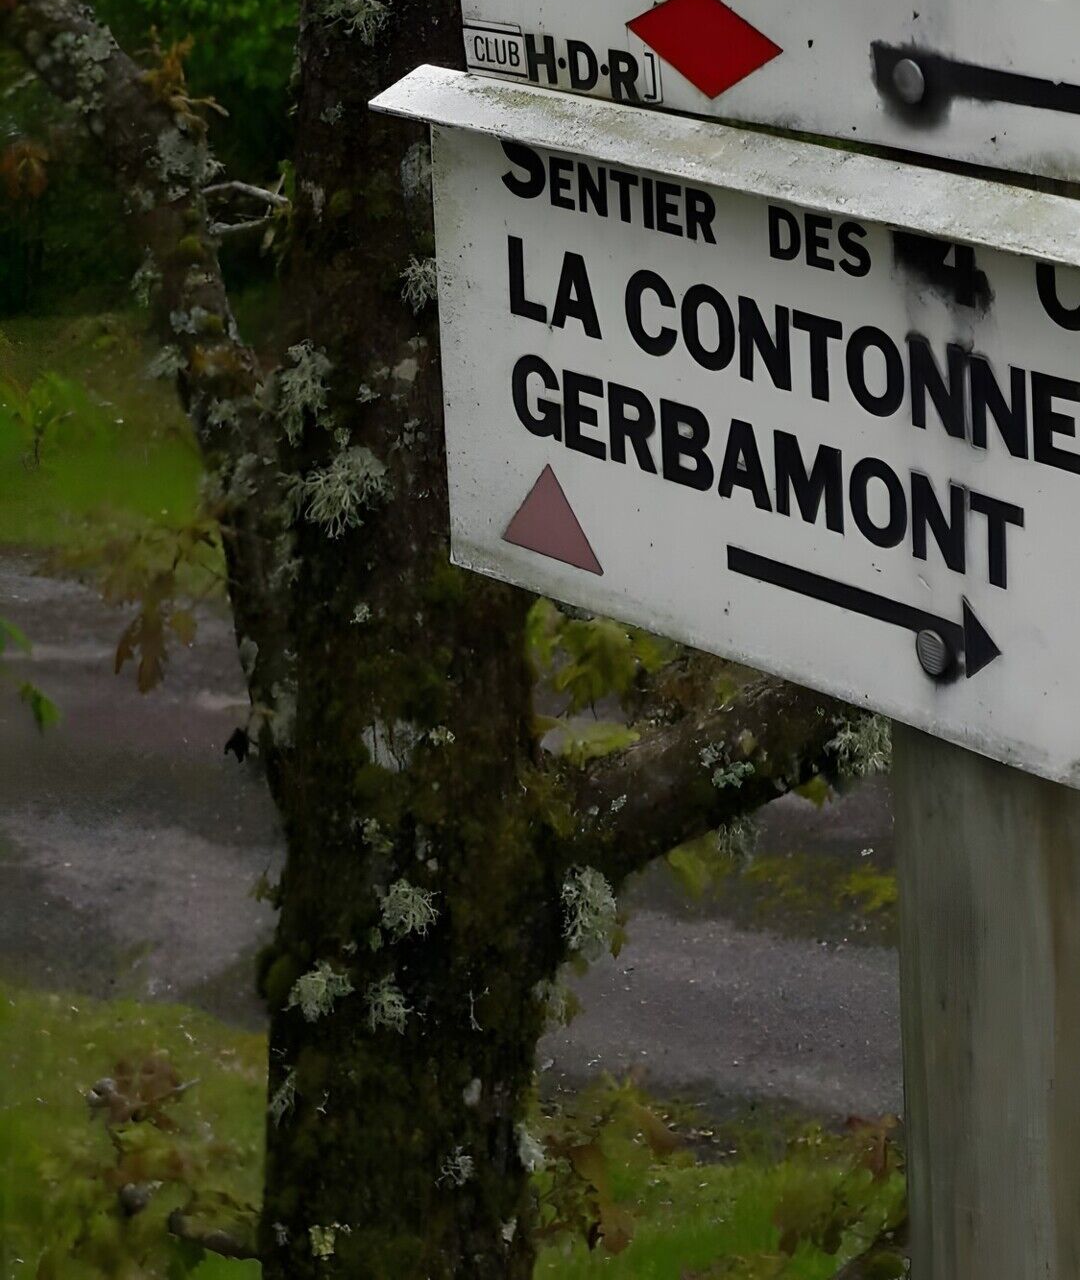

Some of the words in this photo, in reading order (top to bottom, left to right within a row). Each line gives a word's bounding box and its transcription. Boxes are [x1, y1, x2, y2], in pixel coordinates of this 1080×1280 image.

[473, 35, 520, 66] CLUB
[508, 235, 602, 339] LA
[768, 205, 872, 277] DES
[922, 236, 988, 308] 4
[511, 355, 1025, 590] GERBAMONT
